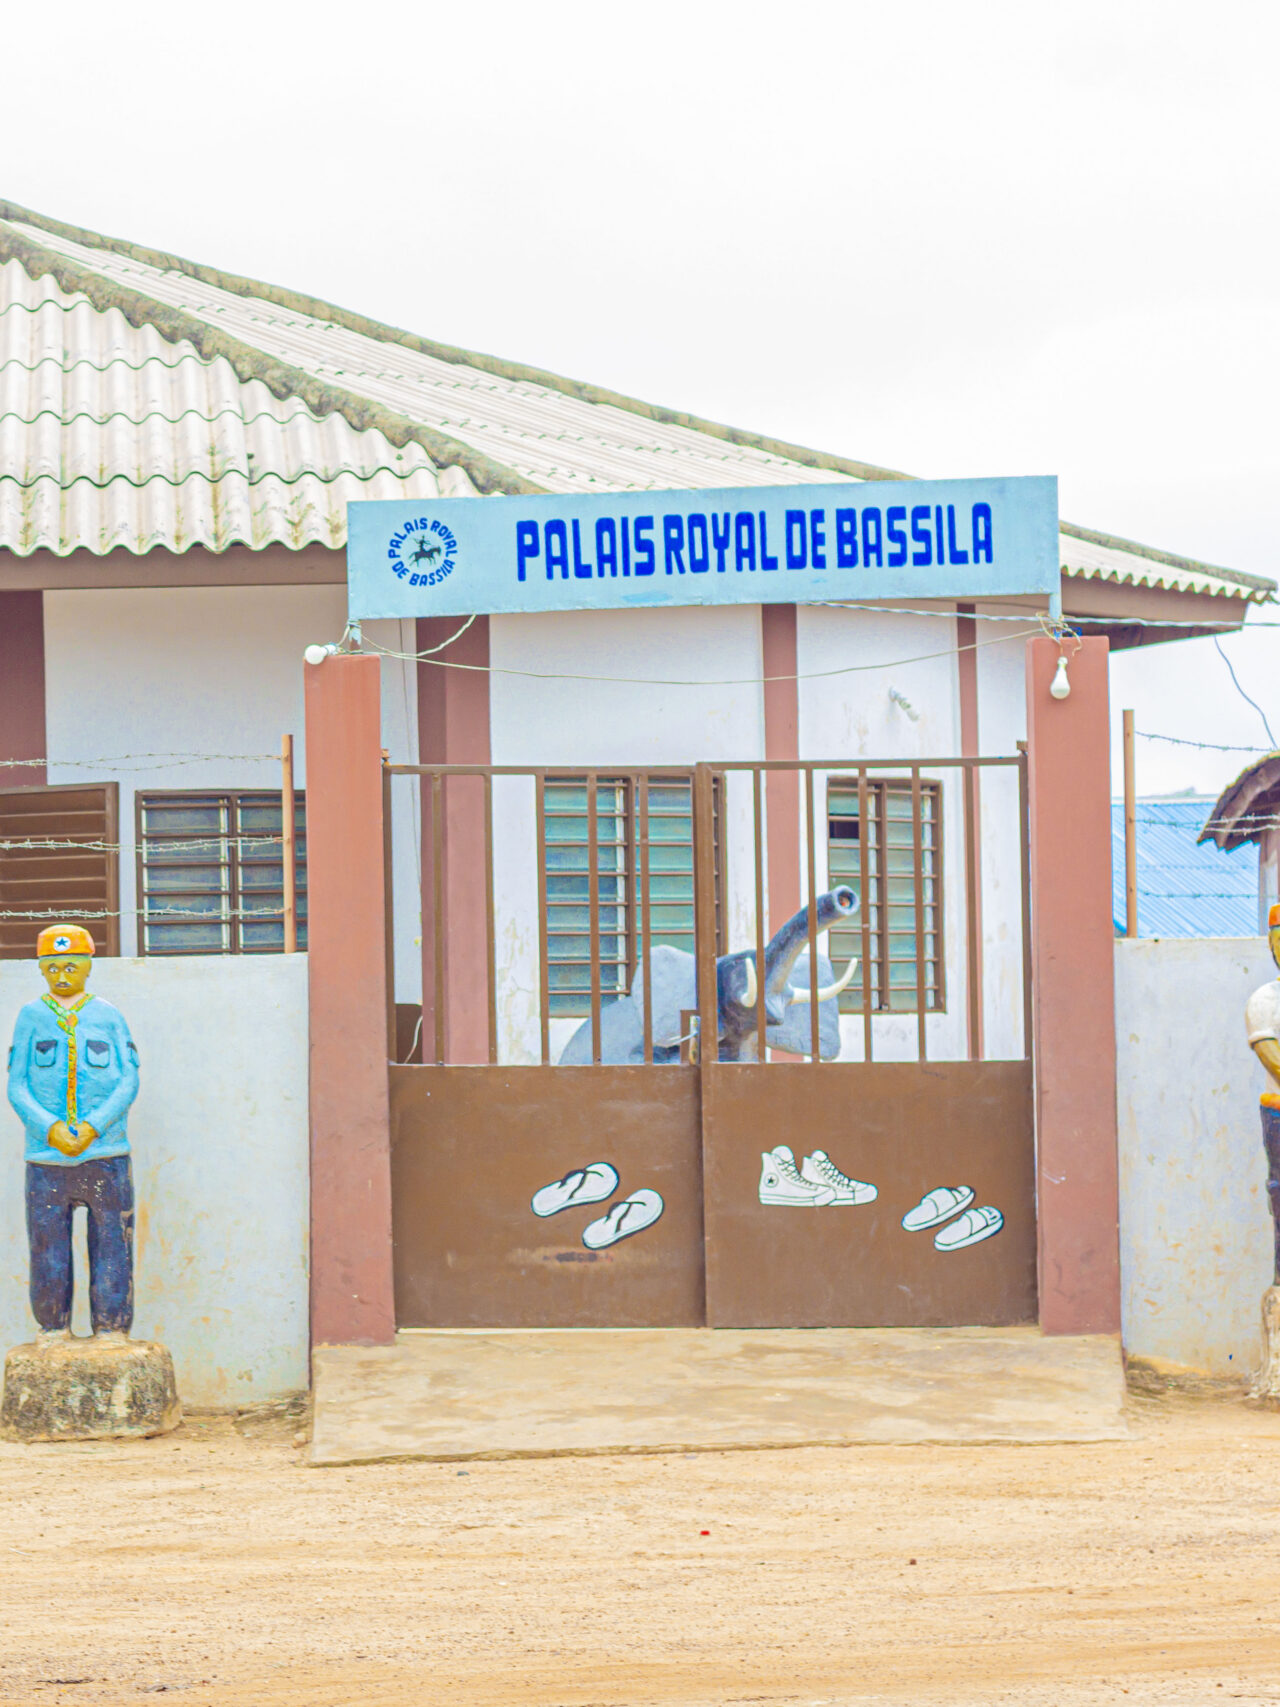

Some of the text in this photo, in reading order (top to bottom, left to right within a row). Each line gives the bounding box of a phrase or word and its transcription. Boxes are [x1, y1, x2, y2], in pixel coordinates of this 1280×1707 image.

[387, 517, 459, 559] PALAIS ROYAL
[515, 502, 994, 583] PALAIS ROYAL DE BASSILA
[391, 558, 456, 587] DE BASSILA
